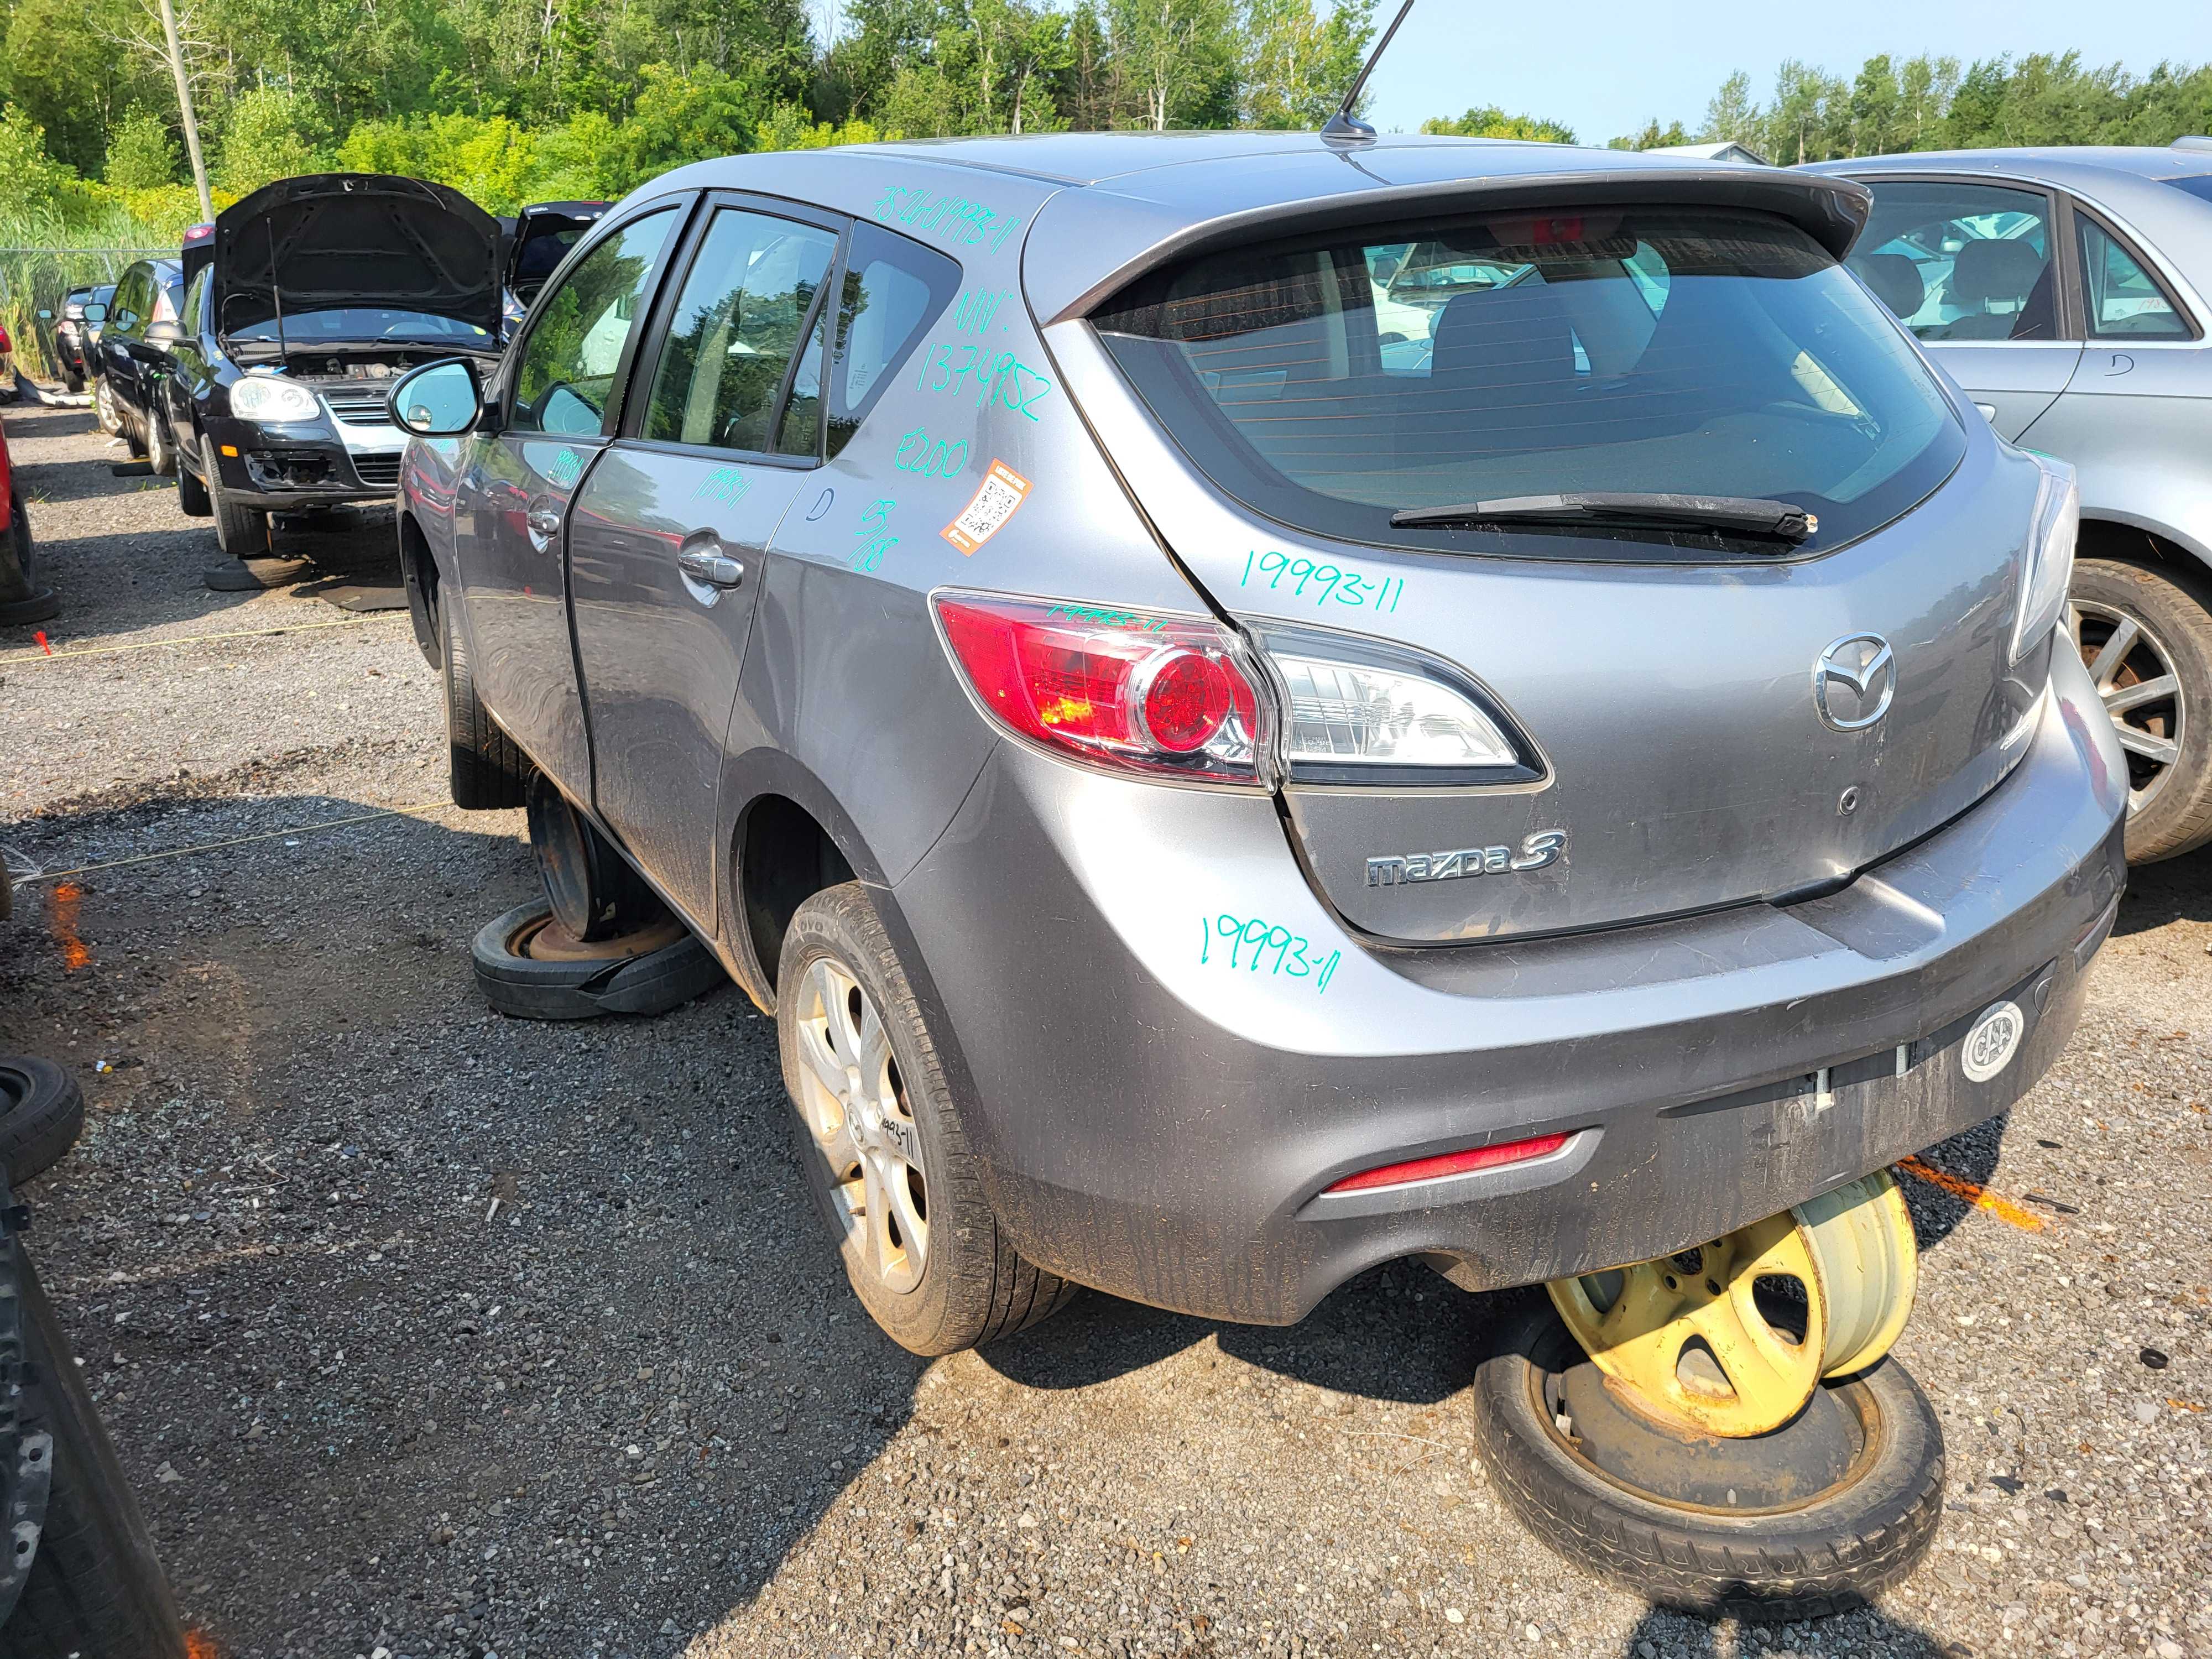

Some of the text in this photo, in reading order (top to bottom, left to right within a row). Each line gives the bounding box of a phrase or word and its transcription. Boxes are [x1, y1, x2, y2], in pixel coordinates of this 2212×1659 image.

[917, 343, 1051, 422] 1374952
[1241, 550, 1404, 613] 19993-11
[1046, 604, 1168, 633] 19993-11
[1202, 914, 1342, 994] 19993-11
